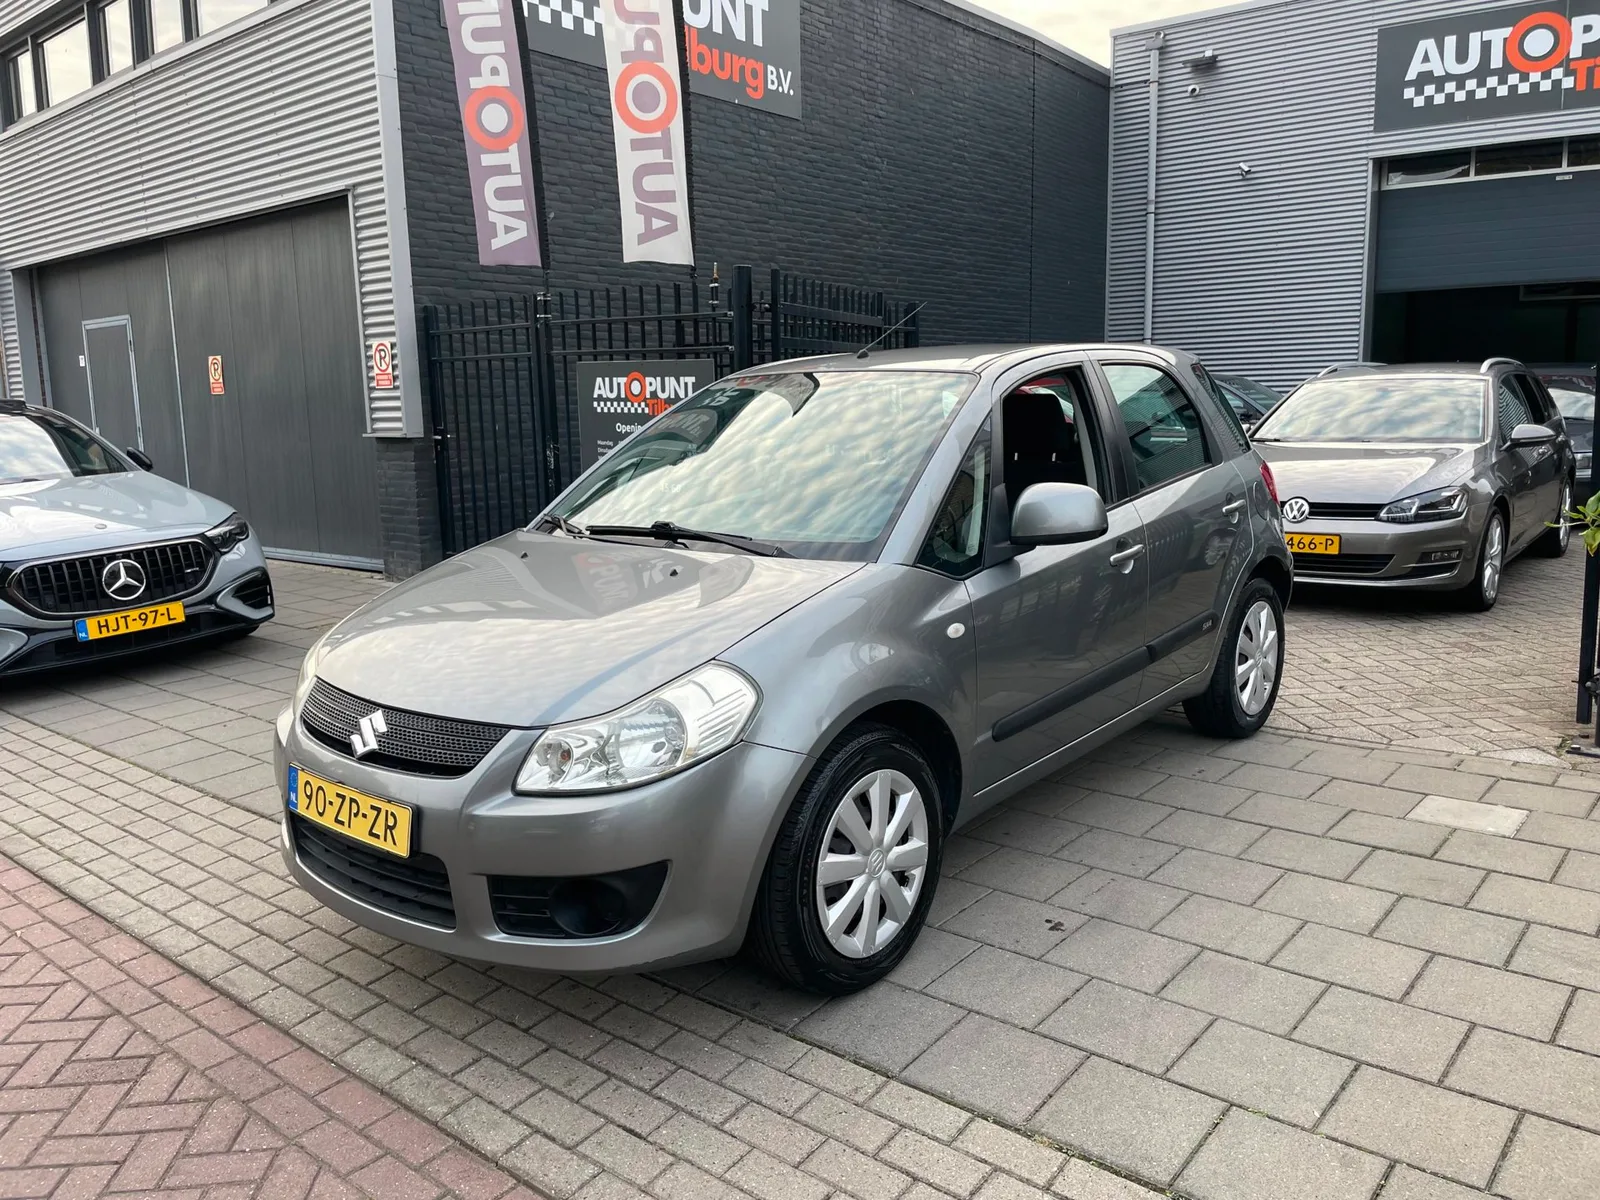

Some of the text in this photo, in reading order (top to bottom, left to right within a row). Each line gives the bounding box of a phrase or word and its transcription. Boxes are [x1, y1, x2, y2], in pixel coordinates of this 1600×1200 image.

[767, 64, 794, 95] B.V.
[593, 371, 696, 403] AUTOPUNT
[646, 398, 675, 416] Tilb
[1286, 536, 1335, 551] 466-P
[97, 607, 177, 634] HJT-97-L
[303, 780, 398, 846] 90-ZP-ZR
